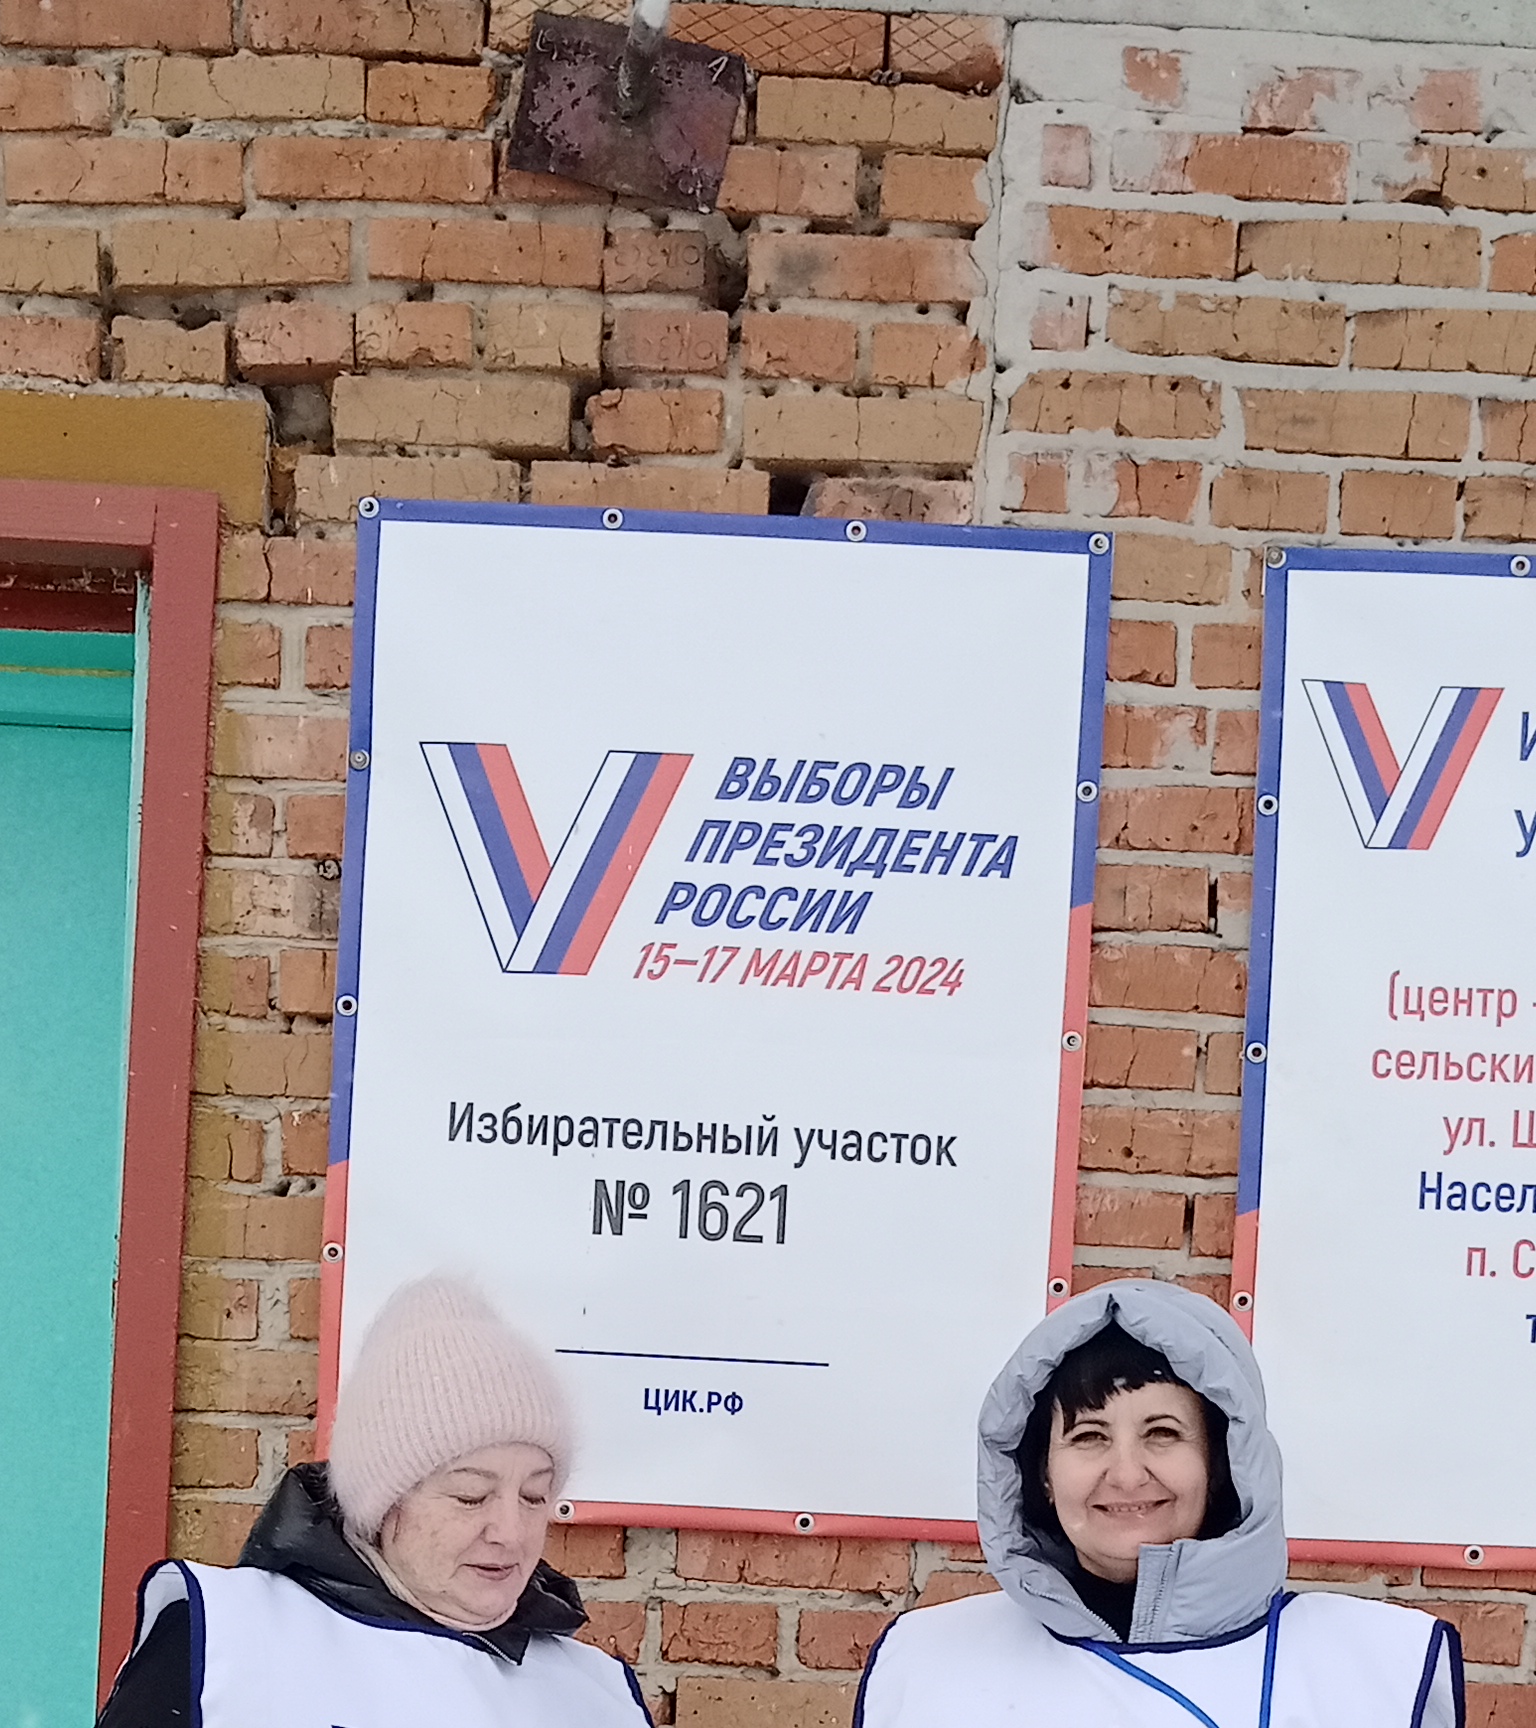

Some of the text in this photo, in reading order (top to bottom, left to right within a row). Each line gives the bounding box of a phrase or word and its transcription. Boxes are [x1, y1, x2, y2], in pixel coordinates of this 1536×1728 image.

[715, 756, 955, 810] ВЫБОРЫ
[685, 819, 1019, 879] ПРЕЗИДЕНТА
[655, 881, 872, 935] РОССИИ
[740, 948, 868, 992] МАРТА
[872, 954, 966, 997] 2024
[1387, 970, 1518, 1027] (центр
[448, 1101, 958, 1168] Избирательный участок
[1442, 1113, 1496, 1156] ул.
[591, 1179, 789, 1245] № 1621
[1465, 1245, 1498, 1278] п.
[643, 1387, 744, 1417] ЦИК.РФ
